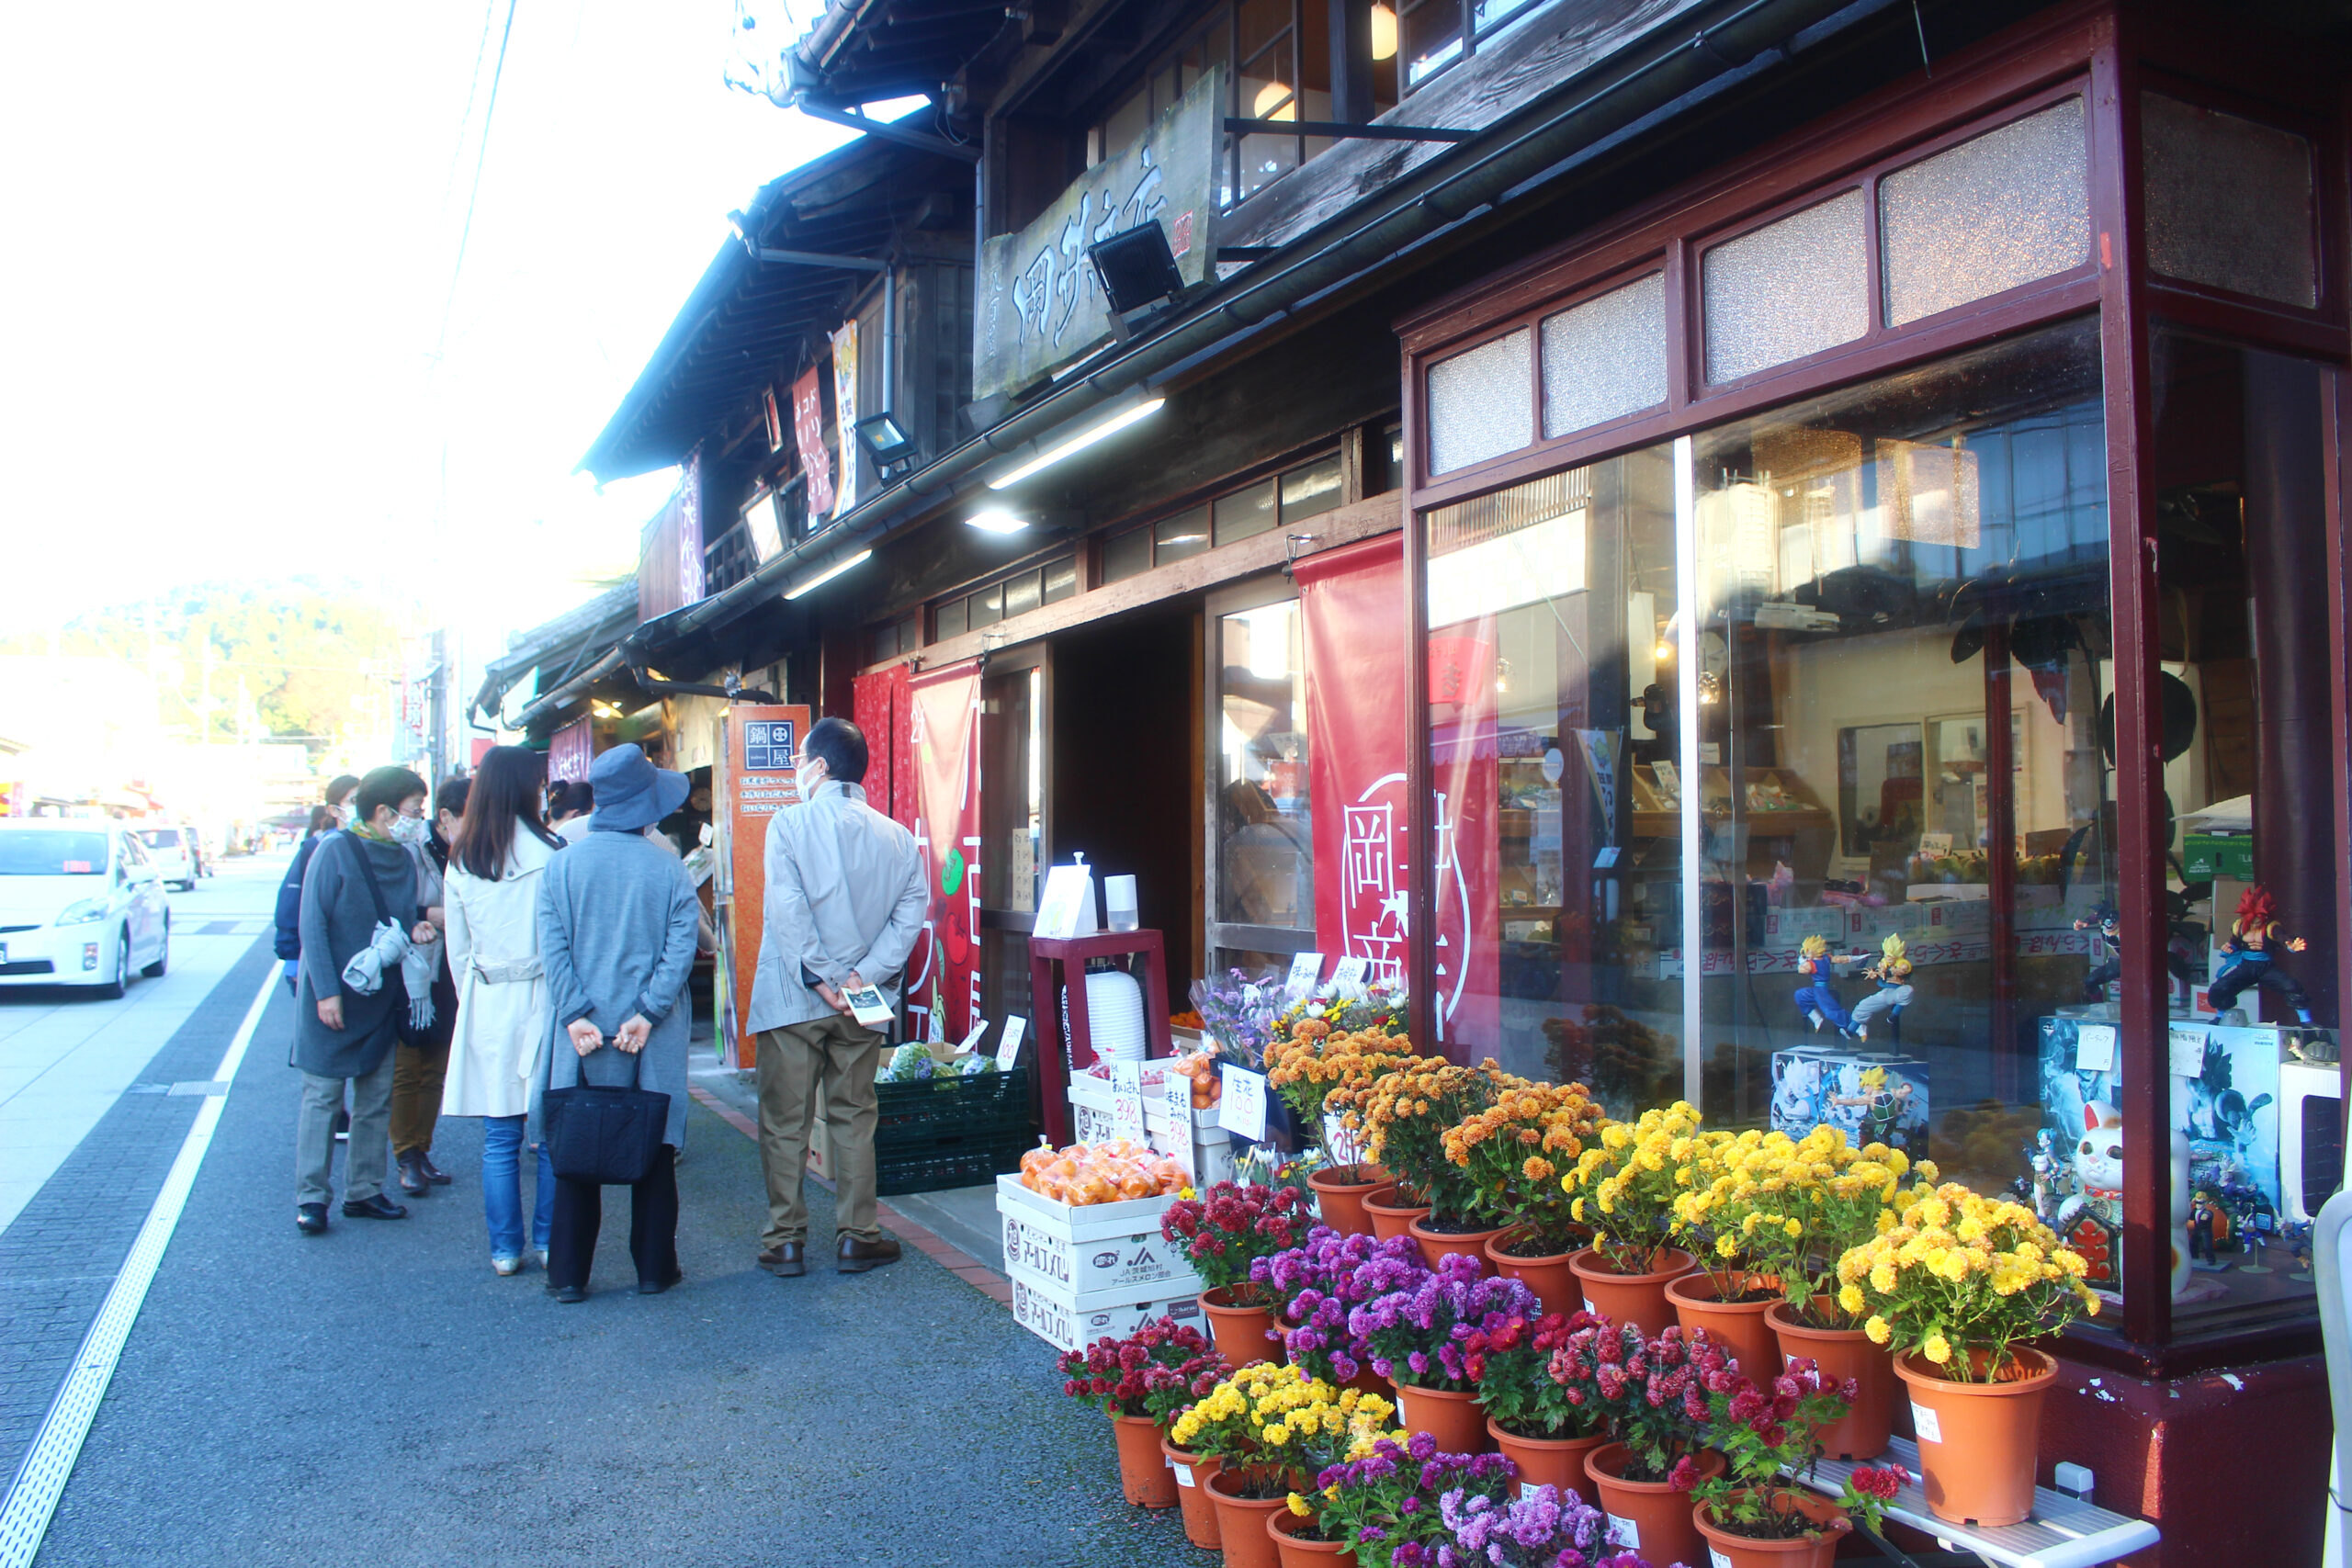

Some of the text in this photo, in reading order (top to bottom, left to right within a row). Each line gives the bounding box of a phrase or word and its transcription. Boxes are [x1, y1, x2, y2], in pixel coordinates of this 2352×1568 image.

[740, 776, 797, 785] お米屋がつくっ
[1232, 1074, 1254, 1097] 生花
[1114, 1099, 1138, 1124] 398
[1229, 1090, 1255, 1115] 100
[1169, 1120, 1190, 1146] 398
